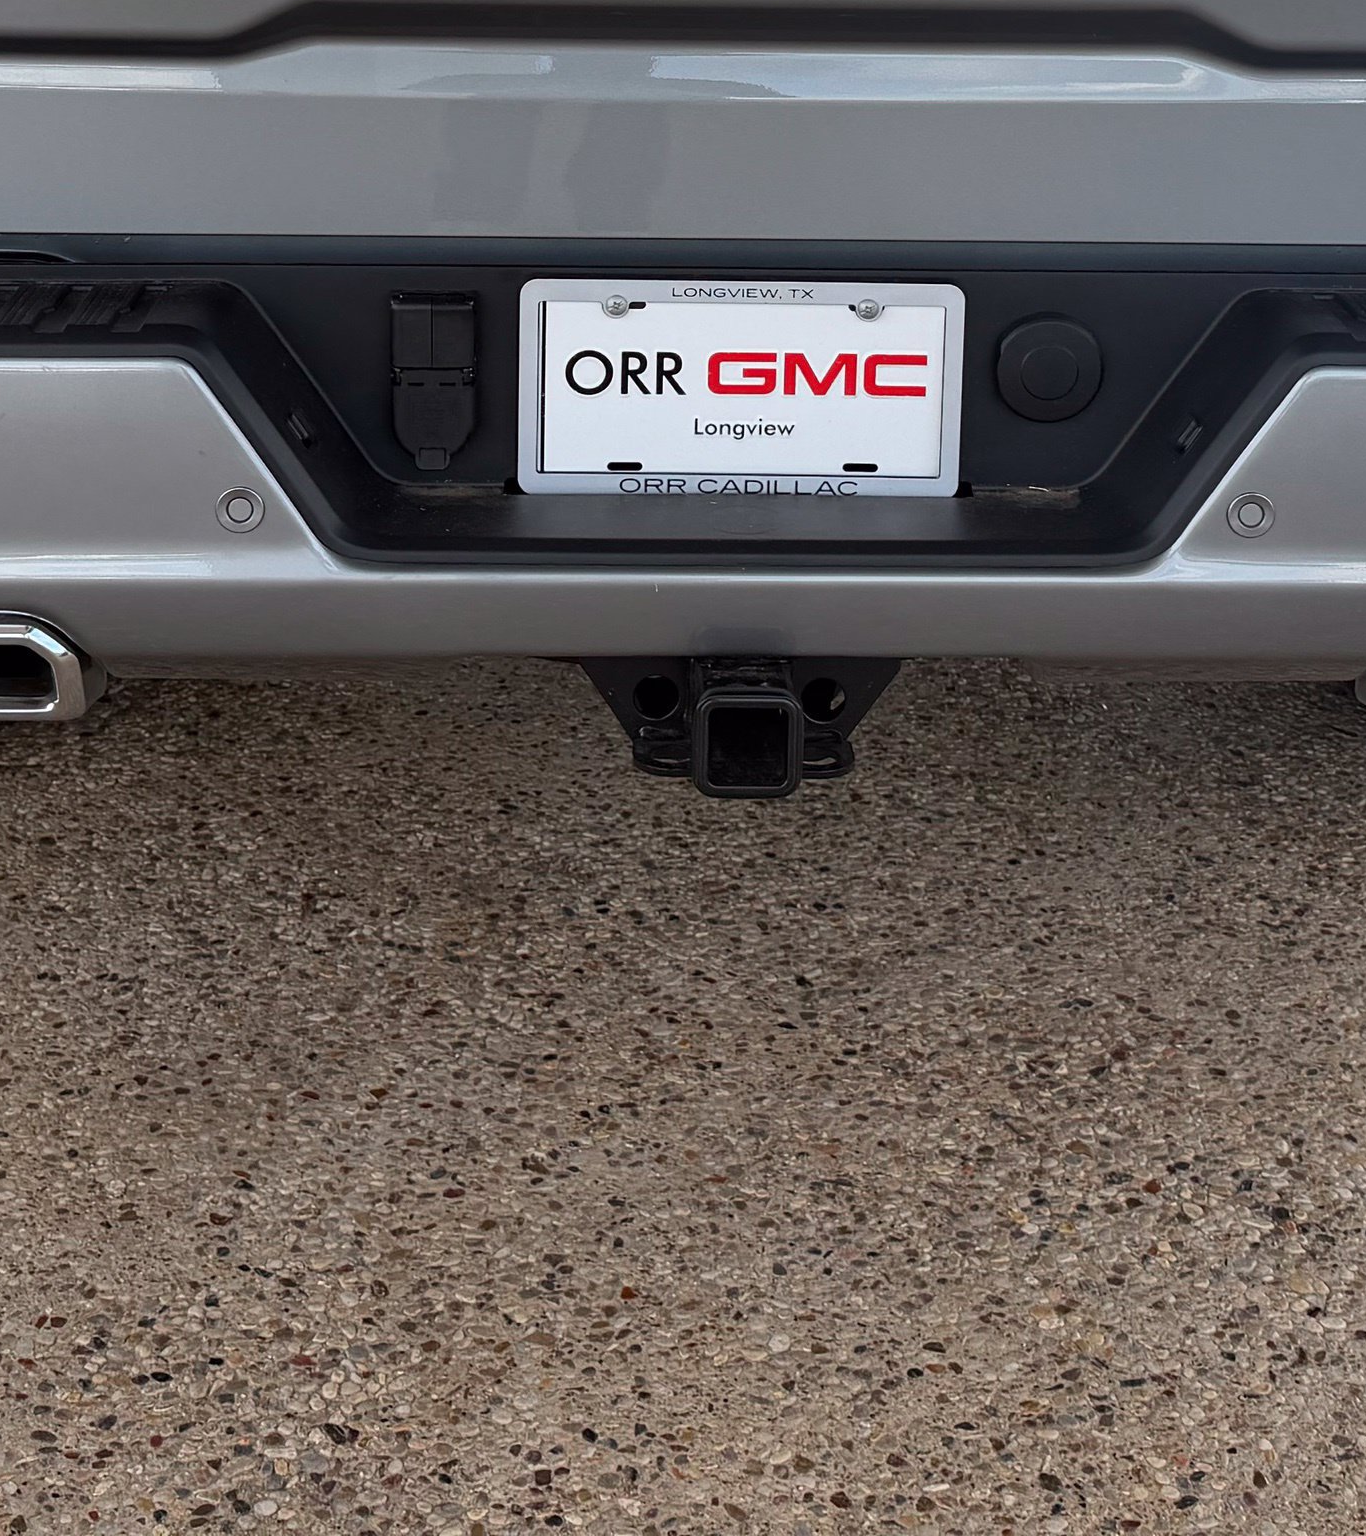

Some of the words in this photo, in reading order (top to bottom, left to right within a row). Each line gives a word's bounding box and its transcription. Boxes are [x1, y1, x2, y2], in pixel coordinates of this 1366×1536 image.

[671, 286, 783, 301] LONGVIEW,
[789, 287, 815, 300] TX
[565, 349, 687, 396] ORR
[707, 351, 929, 398] GMC
[693, 418, 796, 441] Longview
[619, 477, 688, 495] ORR
[697, 478, 859, 497] CADILLAC
